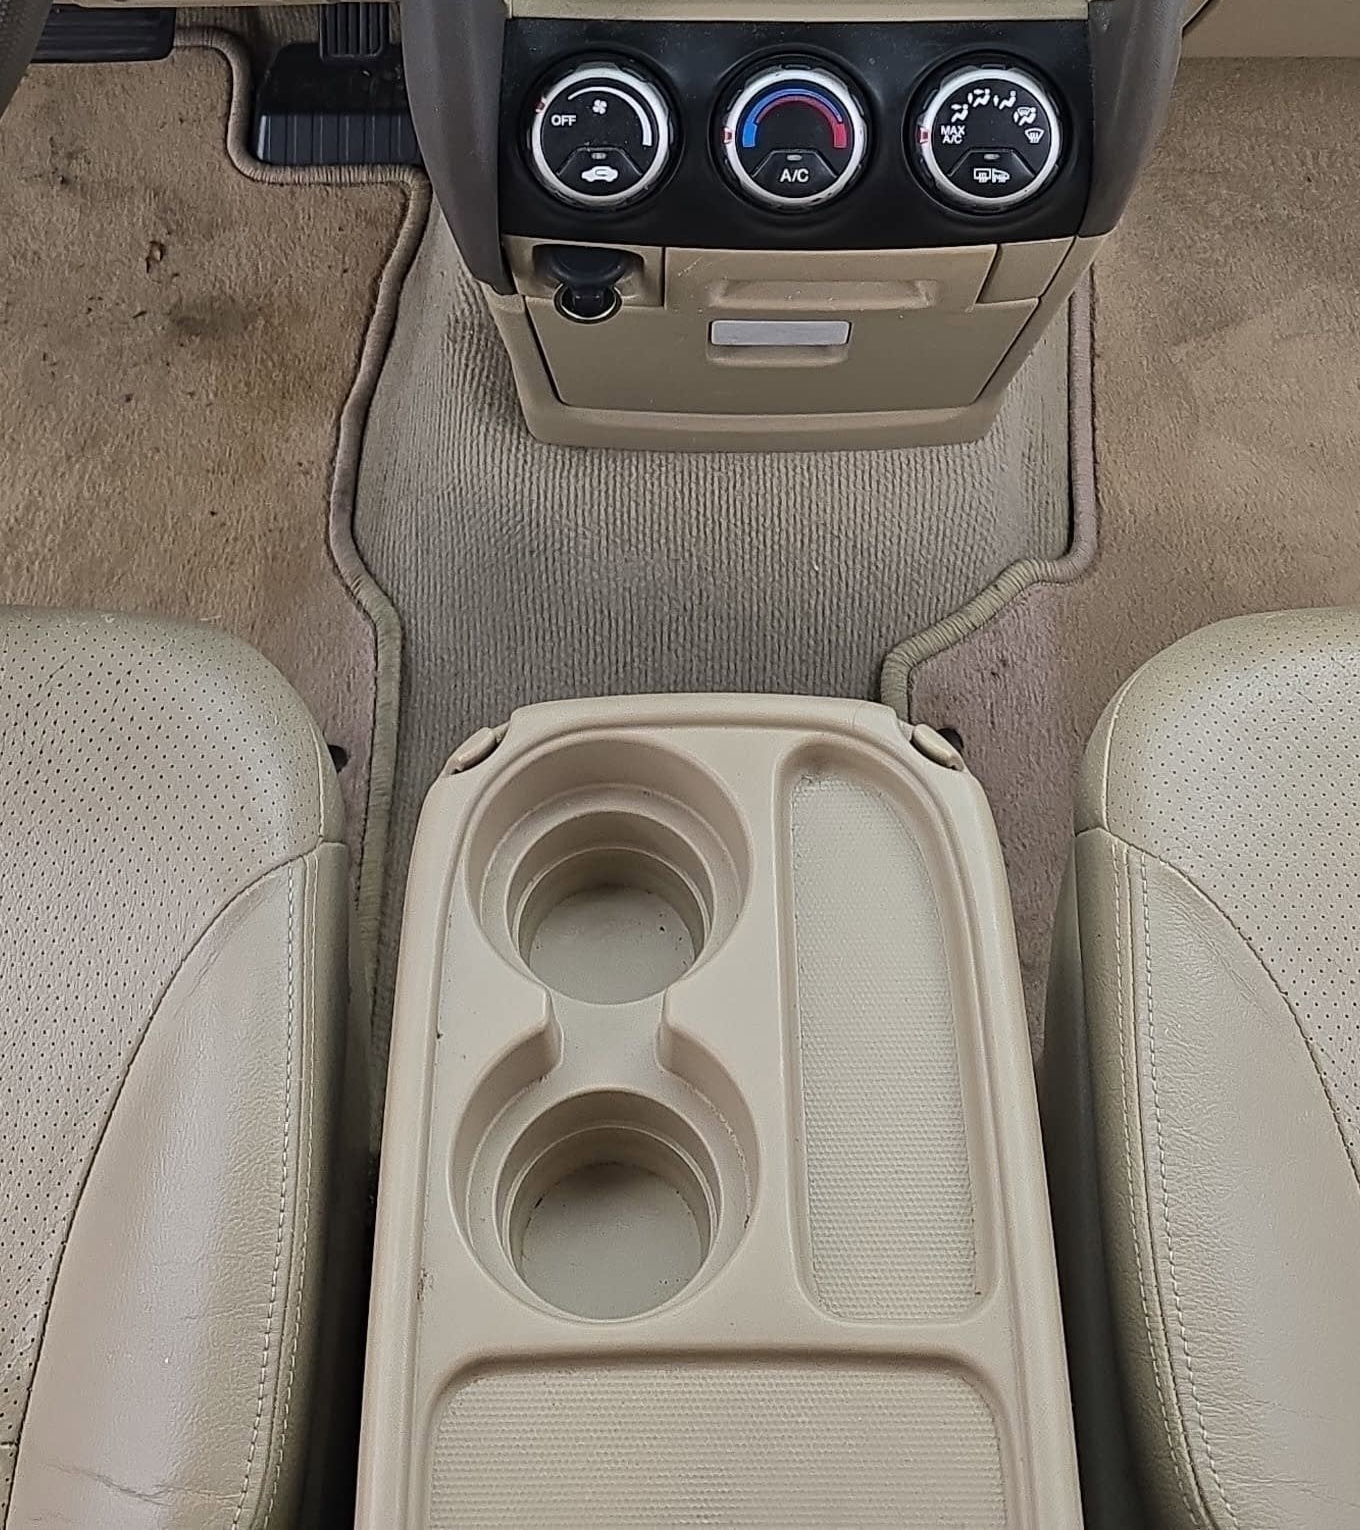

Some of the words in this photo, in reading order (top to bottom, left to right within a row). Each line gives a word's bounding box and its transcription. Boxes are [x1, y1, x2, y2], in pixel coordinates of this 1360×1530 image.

[551, 114, 577, 128] OFF
[940, 126, 967, 138] MAX
[942, 134, 963, 145] A/C
[780, 168, 810, 184] A/C
